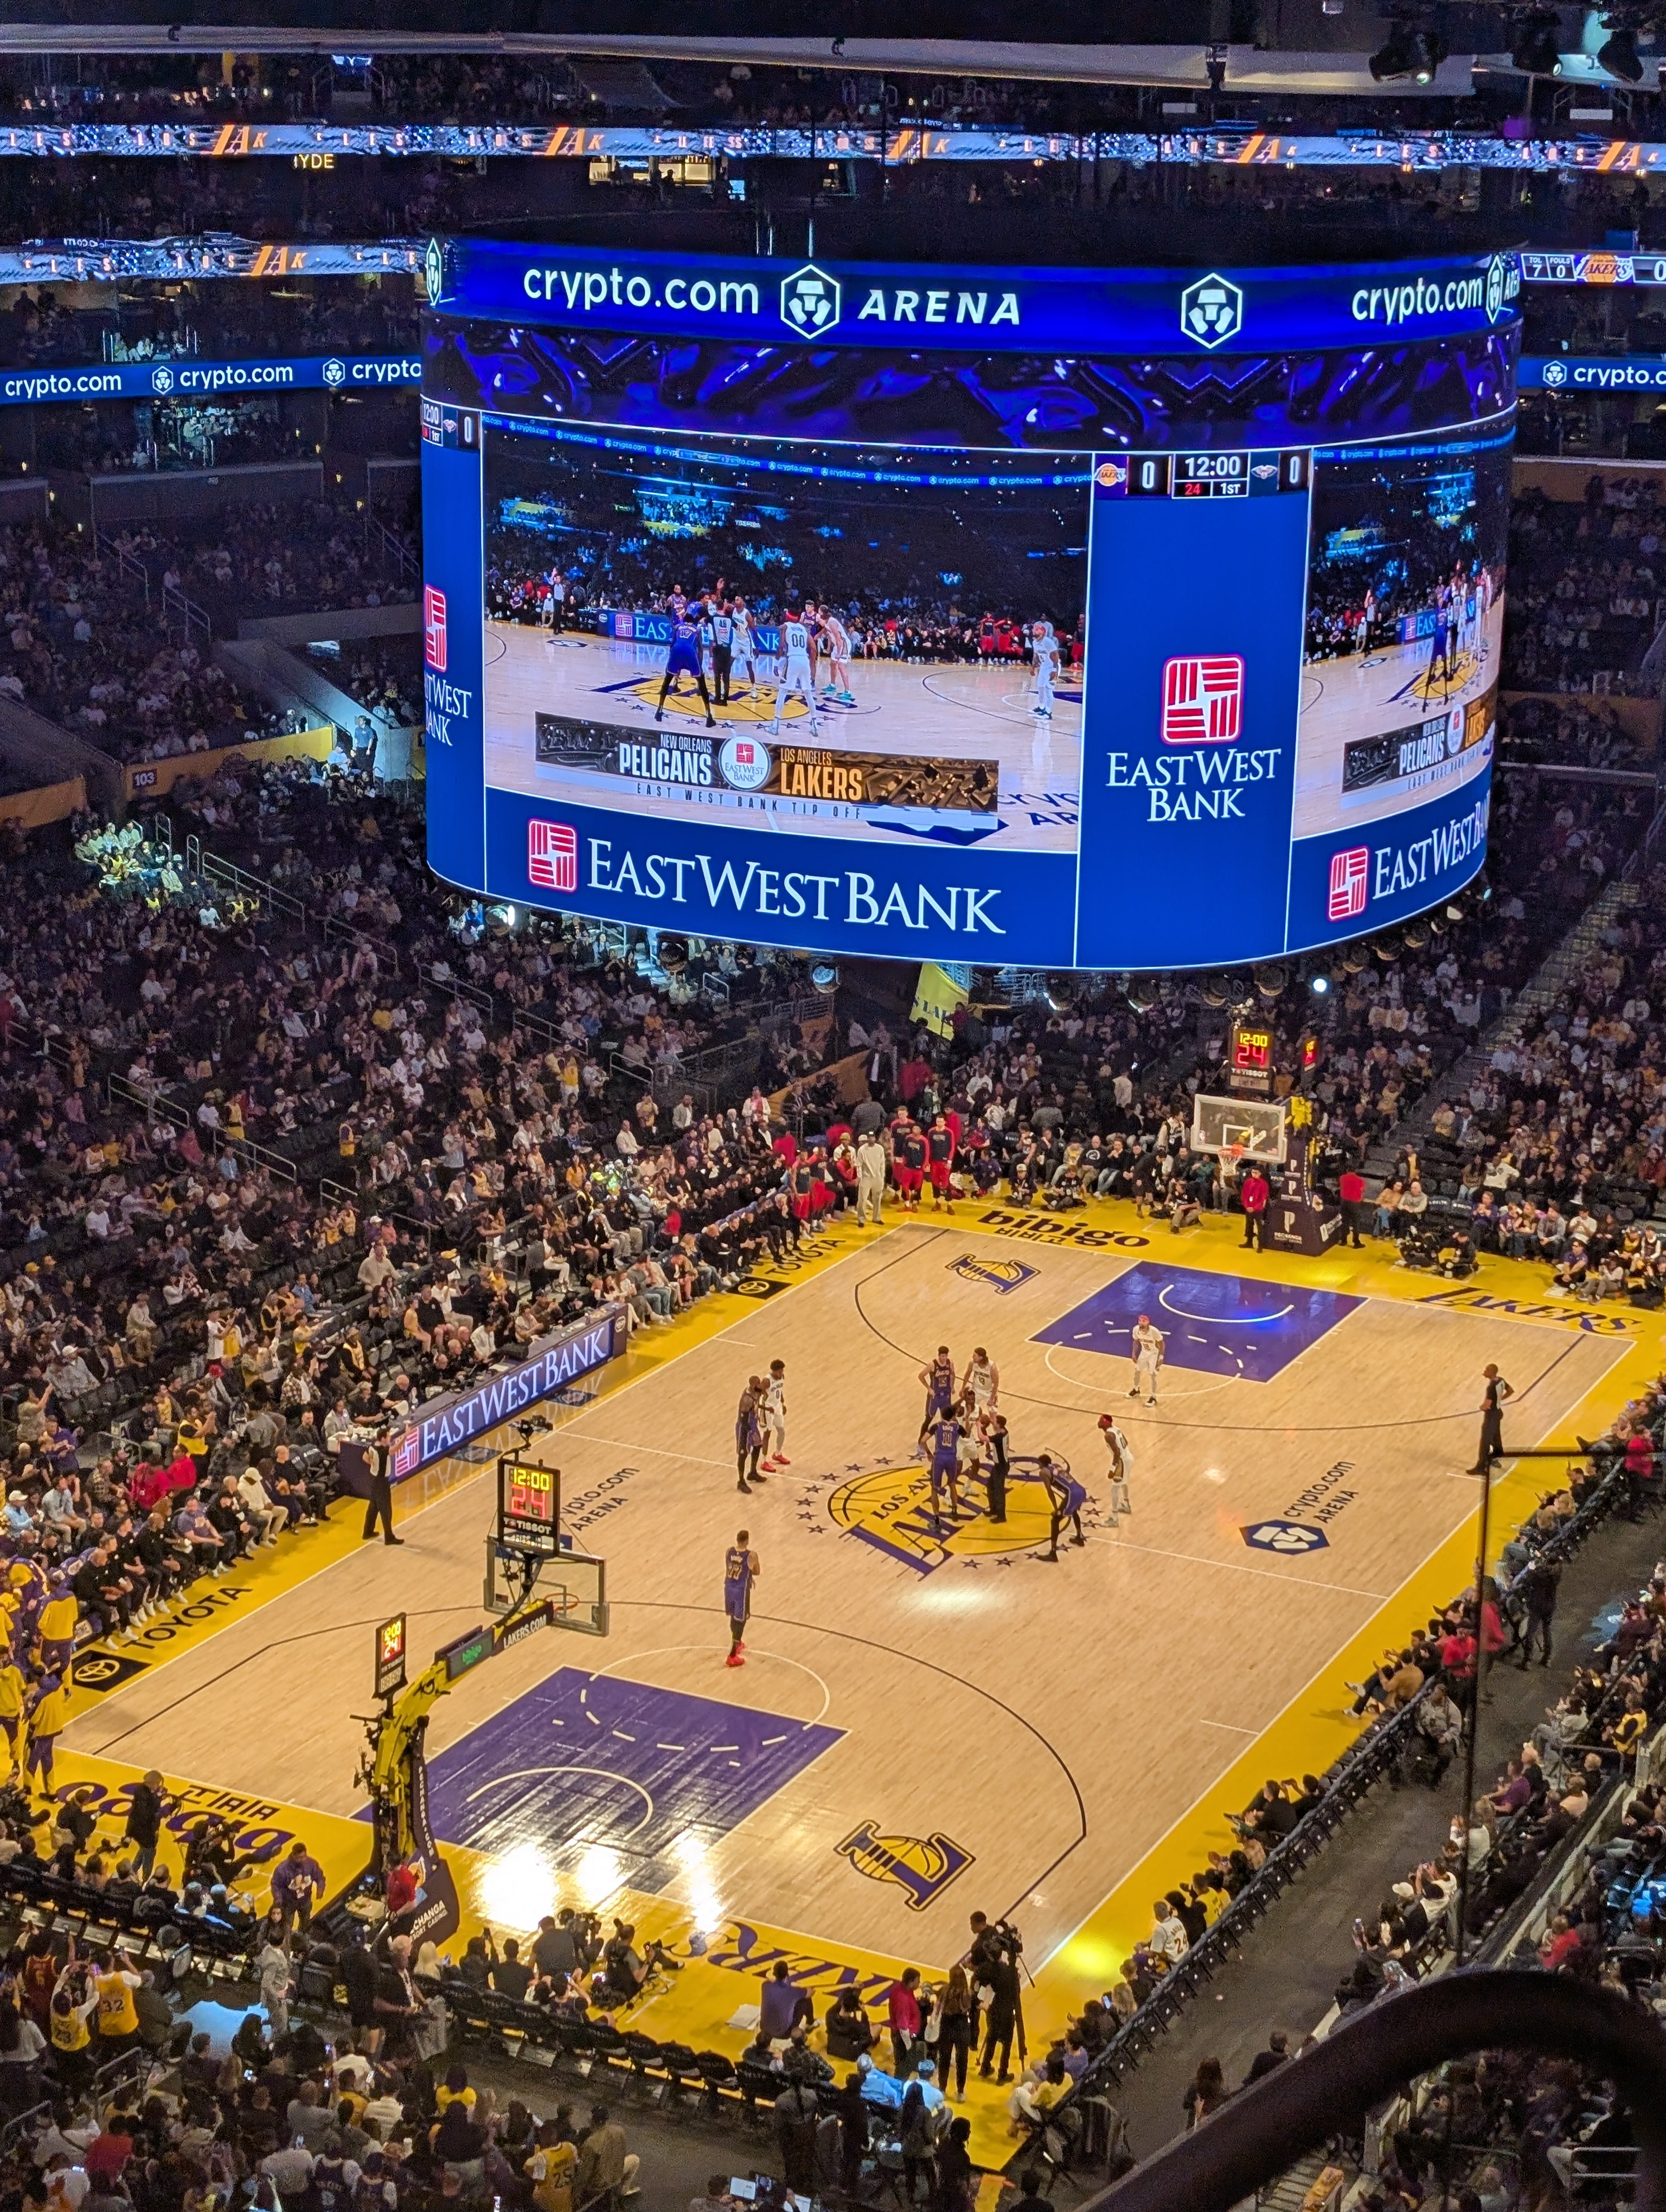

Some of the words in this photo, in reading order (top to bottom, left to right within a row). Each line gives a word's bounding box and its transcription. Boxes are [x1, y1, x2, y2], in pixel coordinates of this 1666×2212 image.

[1533, 265, 1541, 277] 7
[1556, 265, 1565, 278] 0
[1654, 261, 1666, 280] 0
[524, 268, 758, 313] crypto.com
[857, 289, 1020, 325] ARENA
[1353, 277, 1483, 325] crypto.com
[5, 374, 121, 398] crypto.com
[180, 364, 293, 389] crypto.com
[464, 416, 472, 442] 0
[1142, 461, 1155, 488] 0
[1185, 456, 1241, 477] 12:00
[1289, 456, 1300, 484] 0
[1184, 483, 1201, 495] 24
[1220, 483, 1240, 494] 1ST
[792, 633, 805, 648] 00
[661, 734, 678, 750] NEW
[679, 736, 712, 753] ORLEANS
[780, 747, 796, 762] LOS
[797, 749, 832, 765] ANGELES
[1399, 731, 1445, 775] PELICANS
[619, 742, 712, 786] PELICANS
[733, 773, 755, 782] BANK
[133, 773, 155, 787] 103
[780, 762, 862, 800] LAKERS
[637, 782, 671, 799] EAST
[685, 789, 723, 806] WEST
[738, 795, 777, 811] BANK
[792, 801, 818, 816] TIP
[833, 806, 861, 819] OFF
[1147, 788, 1246, 821] BANK
[1240, 1033, 1268, 1047] 12:00
[1237, 1044, 1265, 1069] 24
[1242, 1069, 1268, 1078] TISSOT
[977, 1210, 1150, 1247] bibigo
[765, 1238, 847, 1276] TOYOTA
[1404, 1285, 1644, 1335] LAKERS
[543, 1326, 608, 1391] BANK
[514, 1468, 550, 1491] 12:00
[1283, 1460, 1356, 1518] crypto.com
[511, 1484, 546, 1520] 24
[570, 1496, 629, 1532] ARENA
[870, 1493, 909, 1520] LOS
[1313, 1489, 1359, 1524] ARENA
[517, 1520, 552, 1535] TISSOT
[122, 1585, 254, 1650] TOYOTA
[503, 1614, 547, 1649] LAKERS.COM
